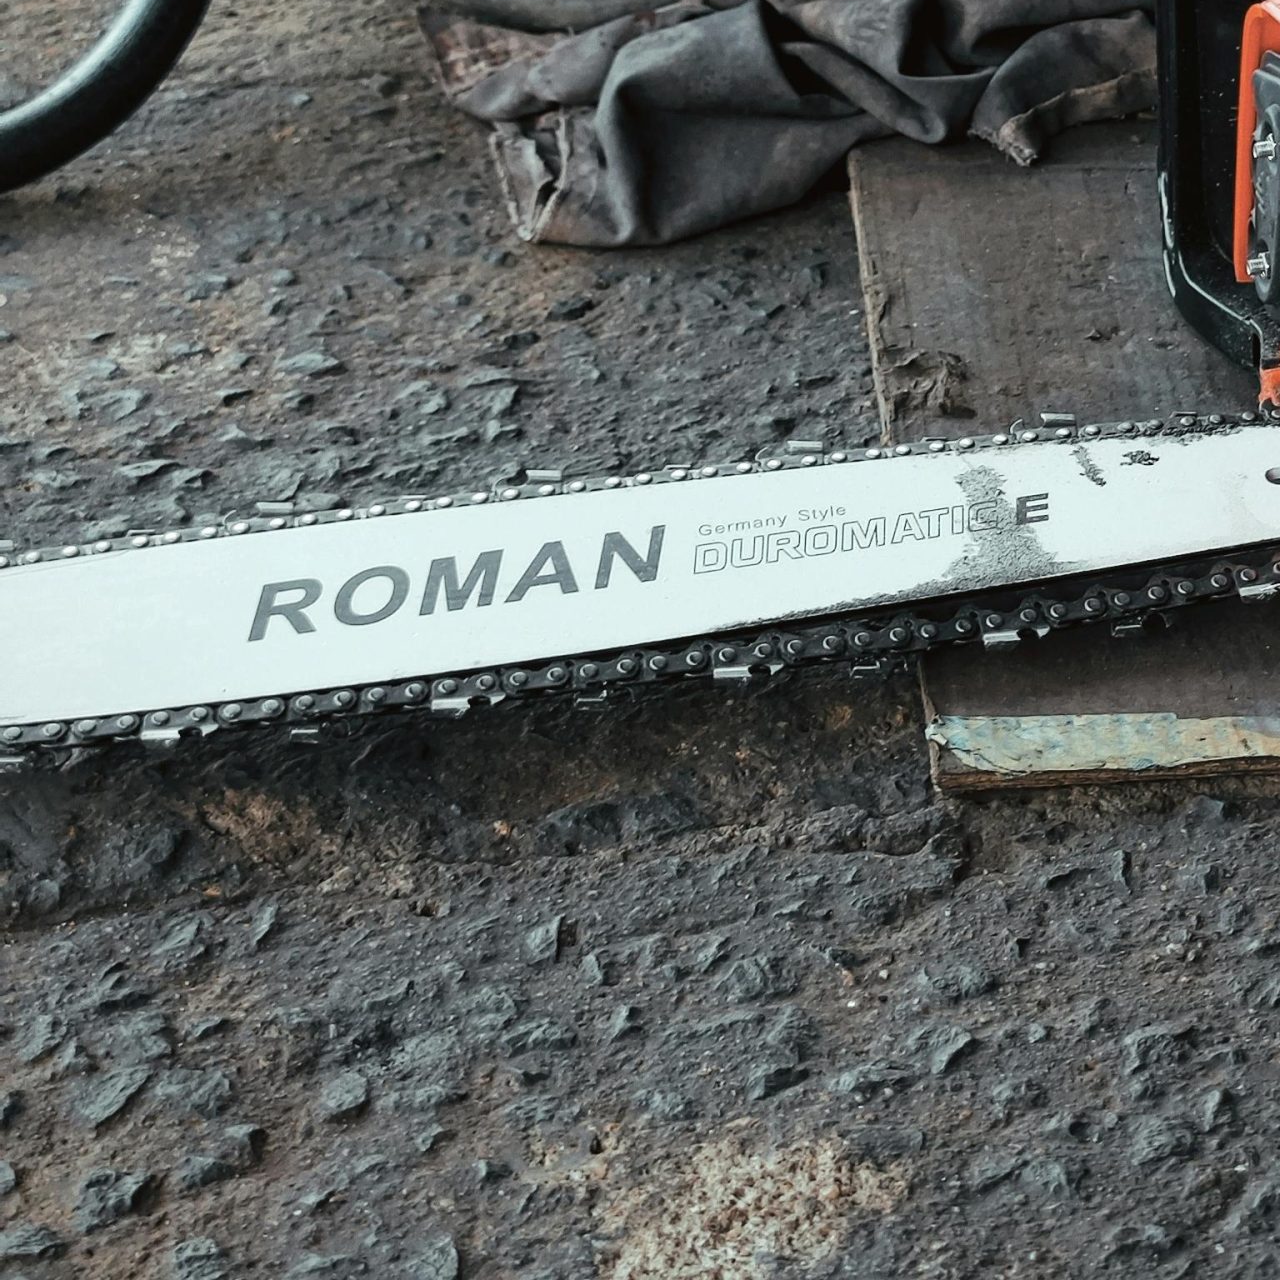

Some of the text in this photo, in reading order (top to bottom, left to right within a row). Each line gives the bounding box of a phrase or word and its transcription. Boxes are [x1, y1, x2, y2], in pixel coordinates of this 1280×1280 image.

[693, 500, 998, 575] DUROMATIC
[698, 505, 846, 536] Germany Style
[248, 525, 666, 642] ROMAN
